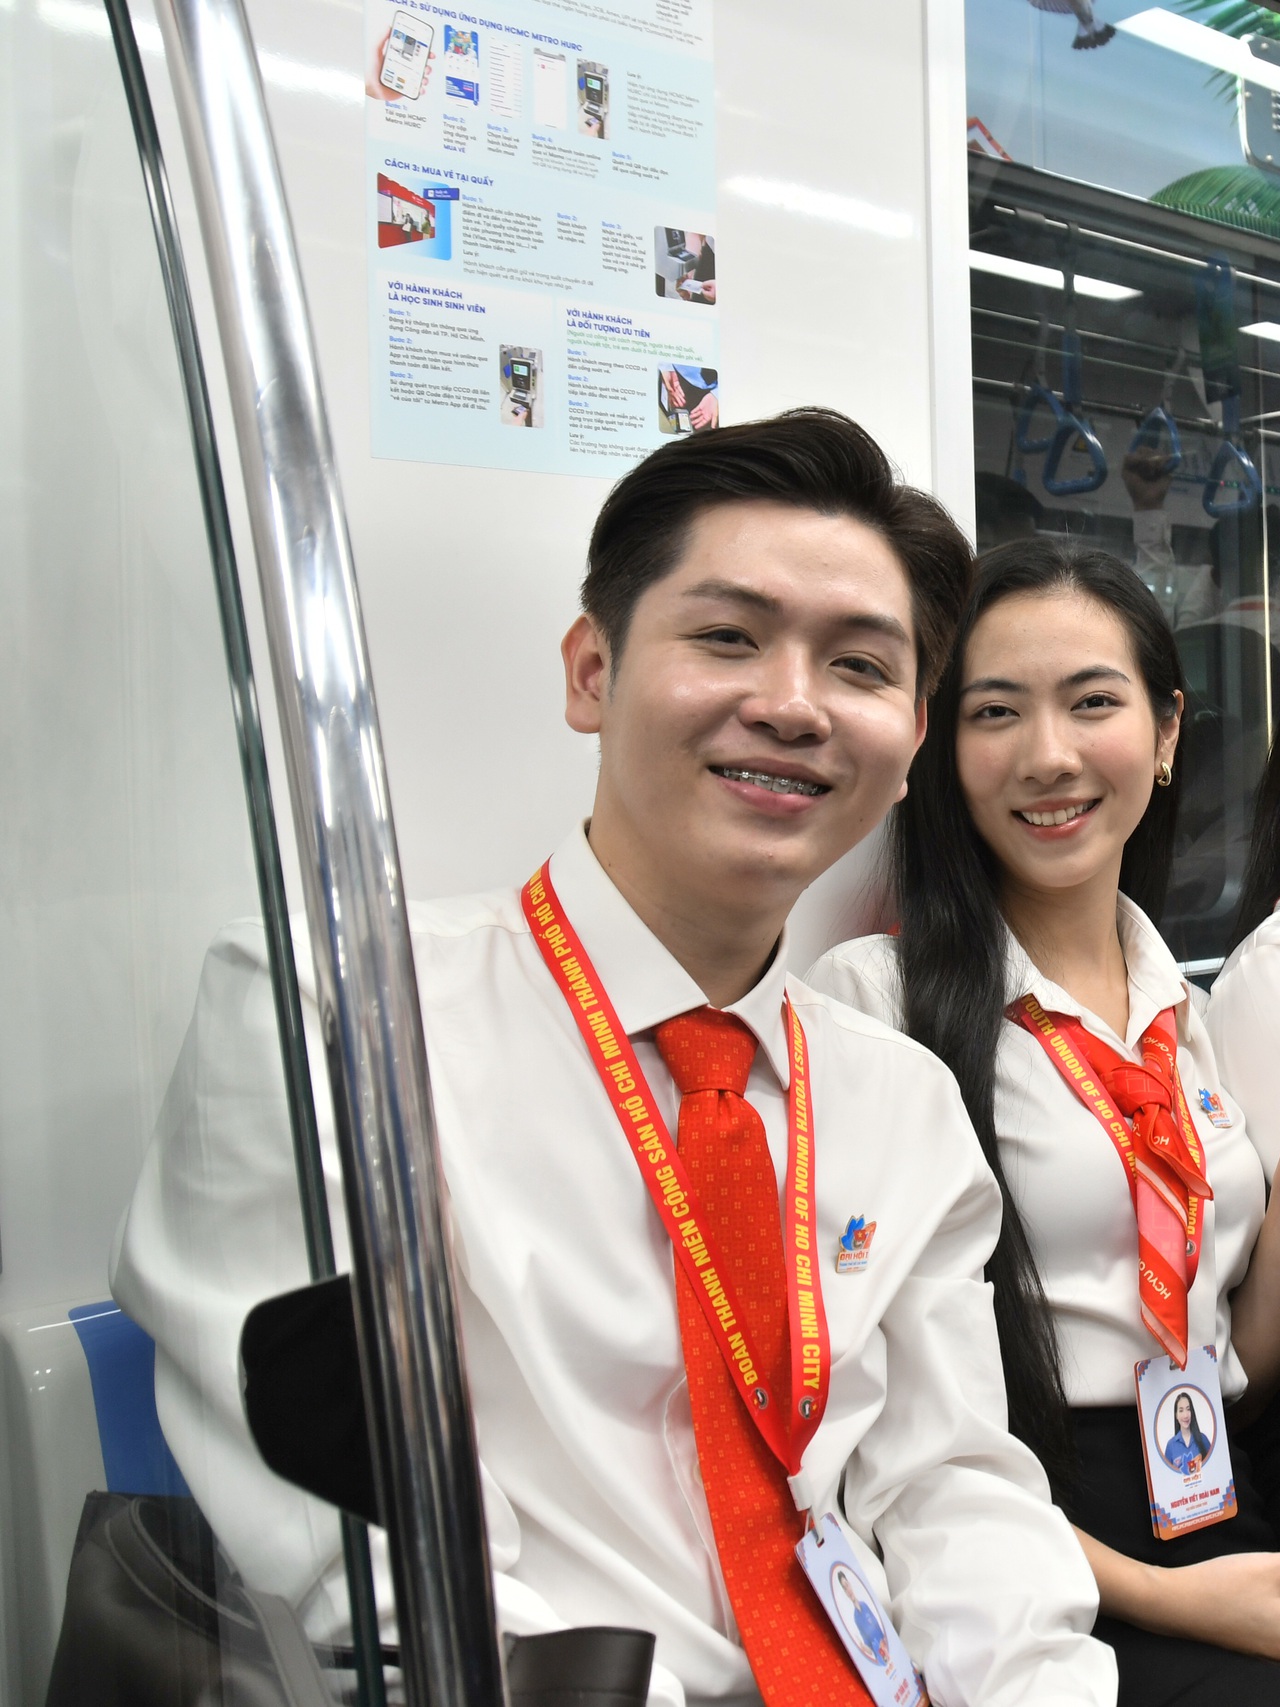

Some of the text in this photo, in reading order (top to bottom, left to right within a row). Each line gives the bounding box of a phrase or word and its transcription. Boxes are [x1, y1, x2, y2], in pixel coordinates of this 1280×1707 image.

[410, 0, 418, 9] 2:
[432, 6, 458, 20] DỤNG
[458, 11, 478, 25] ỨNG
[478, 18, 503, 31] DỤNG
[504, 25, 530, 38] HCMC
[531, 32, 560, 46] METRO
[560, 40, 583, 52] HURC
[385, 116, 404, 125] Metro
[407, 113, 427, 123] HCMC
[384, 158, 411, 171] CÁCH
[412, 164, 420, 173] 3:
[421, 165, 442, 177] MUA
[443, 169, 454, 179] VÉ
[455, 172, 469, 183] TẠI
[387, 280, 463, 300] VỚI HÀNH KHÁCH
[388, 291, 486, 314] LÀ HỌC SINH SINH VIÊN
[566, 308, 633, 326] VỚI HÀNH KHÁCH
[566, 318, 577, 328] LÀ
[577, 320, 592, 330] ĐỐI
[593, 323, 621, 334] TƯỢNG
[633, 328, 651, 339] TIÊN
[459, 353, 477, 361] online
[425, 390, 442, 398] Code
[431, 399, 449, 407] Metro
[531, 902, 556, 927] HỒ
[538, 923, 572, 959] PHỐ
[559, 956, 599, 1011] THÀNH
[586, 1010, 622, 1060] MINH
[605, 1060, 636, 1094] CHÍ
[1021, 993, 1057, 1037] YOUTH
[1050, 1034, 1087, 1081] UNION
[1081, 1079, 1102, 1099] OF
[1093, 1099, 1115, 1121] HO
[1110, 1121, 1132, 1148] CHI
[619, 1095, 650, 1123] HỒ
[795, 1077, 808, 1133] YOUTH
[637, 1123, 667, 1164] SẢN
[795, 1134, 809, 1194] UNION
[655, 1165, 690, 1218] CỘNG
[795, 1196, 809, 1222] OF
[678, 1219, 712, 1268] NIÊN
[795, 1226, 810, 1251] HO
[795, 1253, 813, 1286] CHI
[1143, 1269, 1172, 1300] HCYU
[700, 1267, 737, 1332] THANH
[798, 1289, 819, 1339] MINH
[727, 1332, 759, 1386] ĐOÀN
[802, 1343, 821, 1390] CITY
